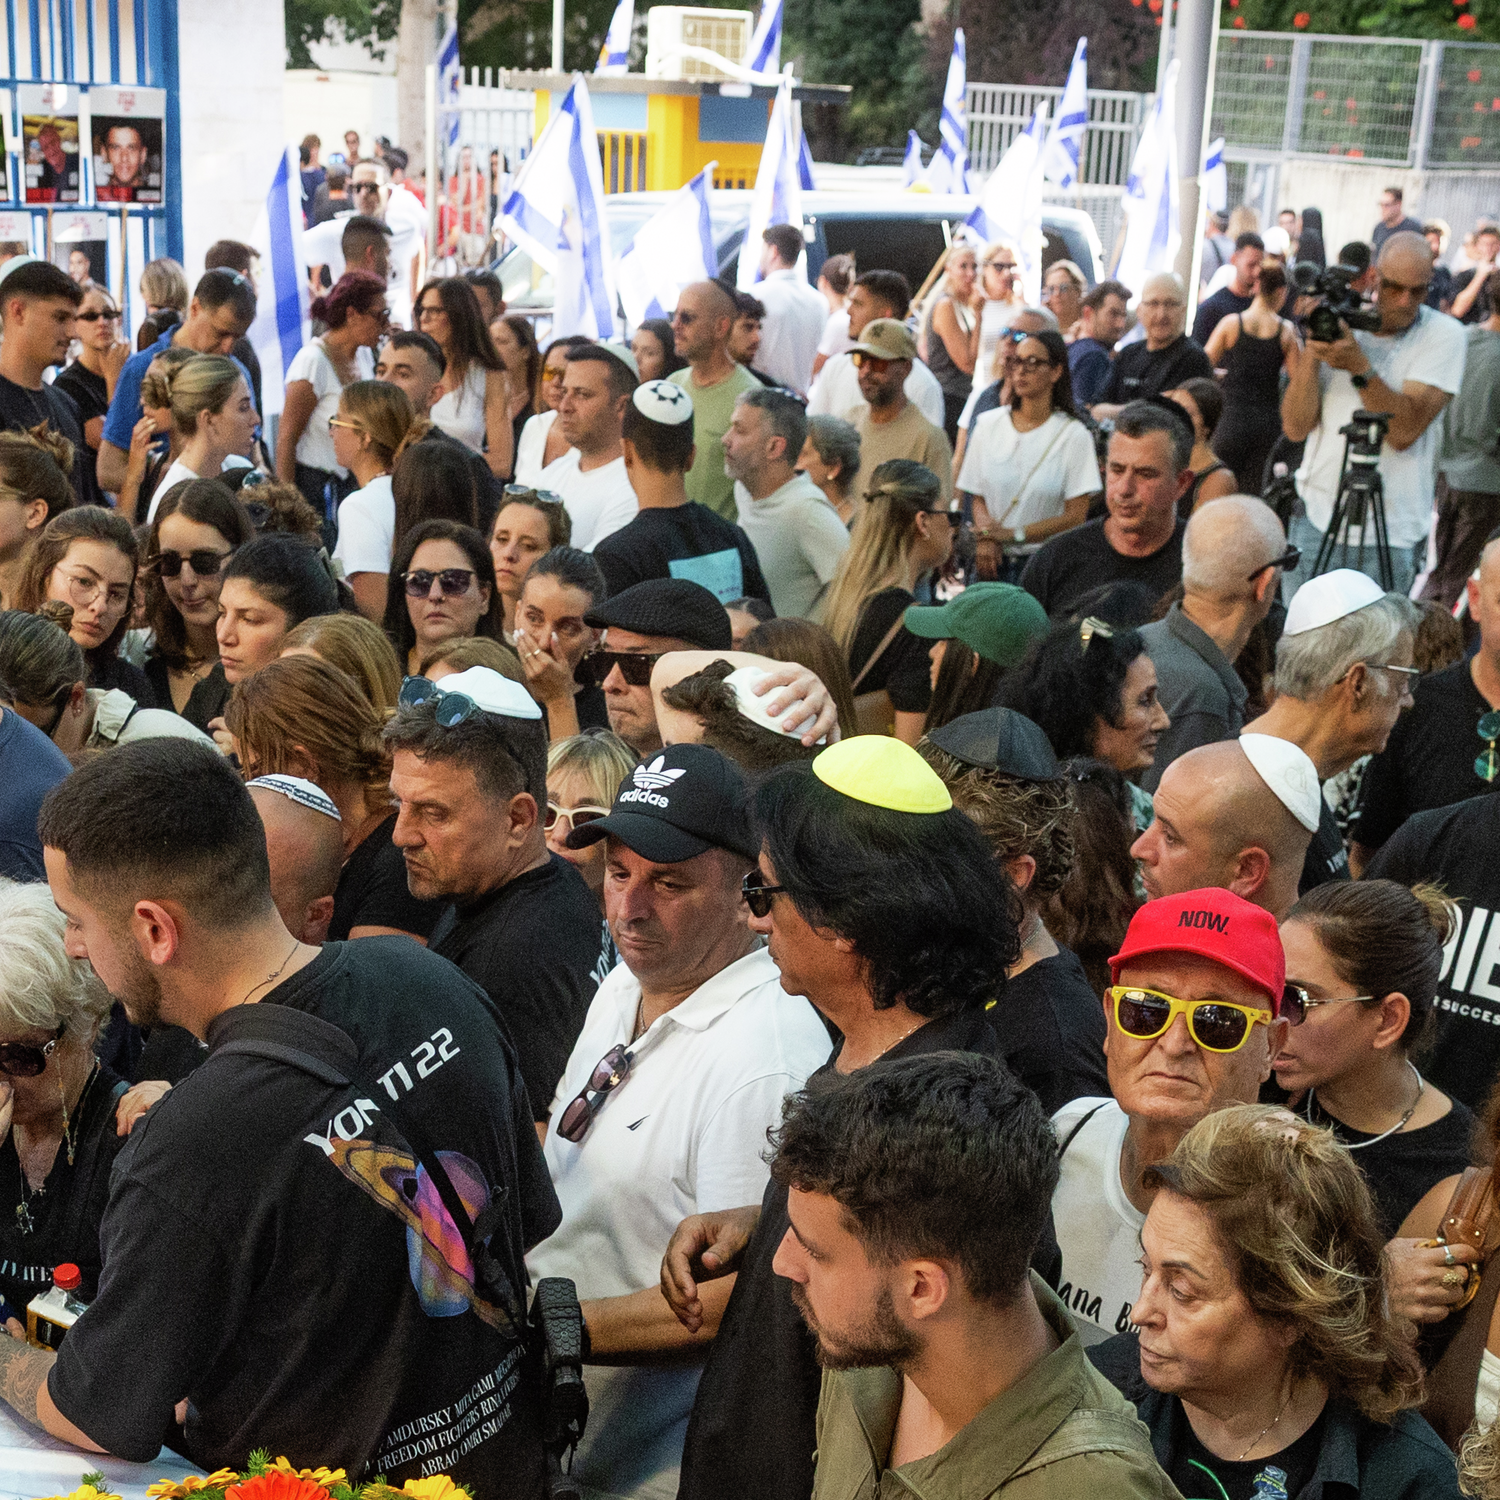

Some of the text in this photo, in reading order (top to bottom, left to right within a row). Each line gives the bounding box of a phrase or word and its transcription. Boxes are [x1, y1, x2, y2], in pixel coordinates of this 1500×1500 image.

[619, 788, 669, 809] adidas
[1178, 910, 1230, 936] NOW.
[410, 1027, 461, 1080] 22
[377, 1434, 438, 1473] FREEDOM
[437, 1406, 481, 1448] FIGHTERS
[386, 1406, 452, 1449] AMDURSKY
